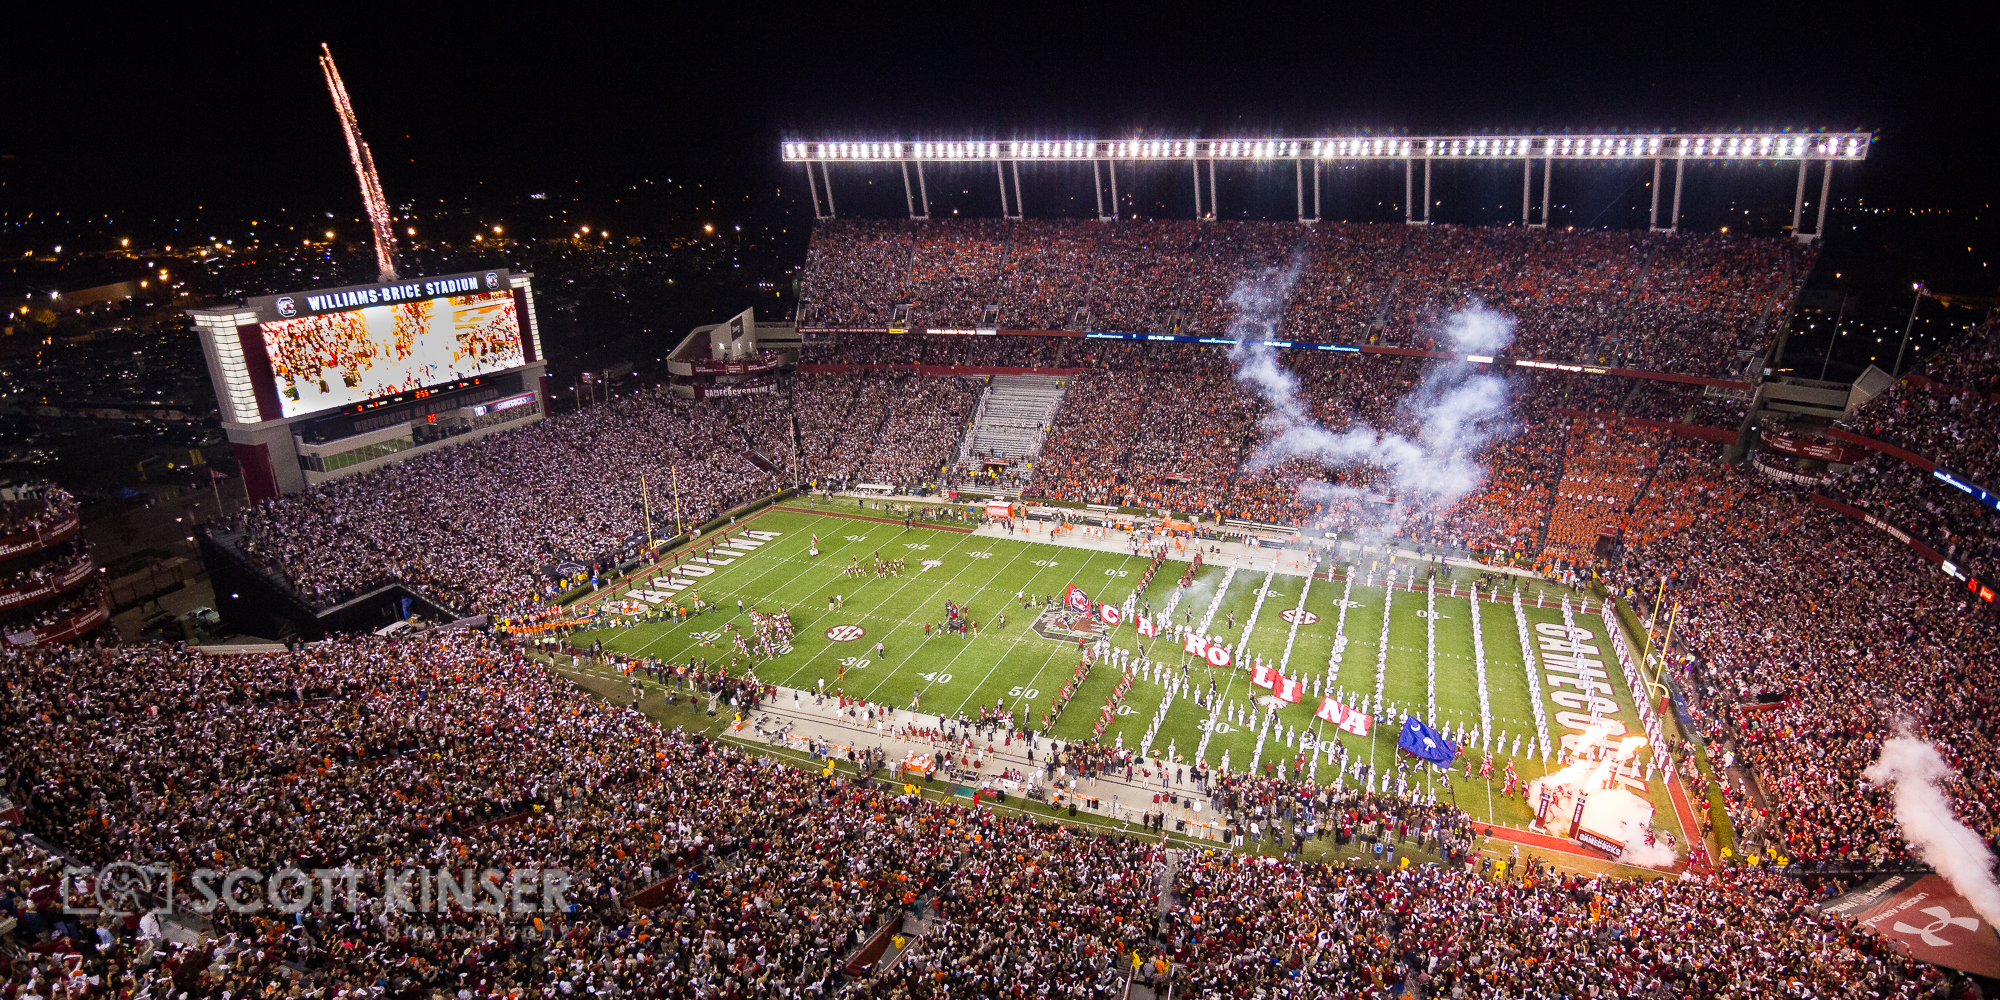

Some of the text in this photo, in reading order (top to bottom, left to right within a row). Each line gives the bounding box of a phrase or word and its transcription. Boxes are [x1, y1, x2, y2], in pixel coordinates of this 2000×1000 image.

[307, 277, 479, 311] WILLIAMS-BRICE STADIUM
[354, 409, 411, 431] UNIVERSITY
[415, 406, 426, 417] OF
[429, 399, 457, 413] SOUTH
[426, 414, 437, 423] 25
[1104, 568, 1128, 577] 50
[828, 625, 864, 641] SEC
[1008, 686, 1039, 699] 50
[1579, 833, 1621, 856] GAMECOCKS
[1896, 892, 1929, 910] UNDER
